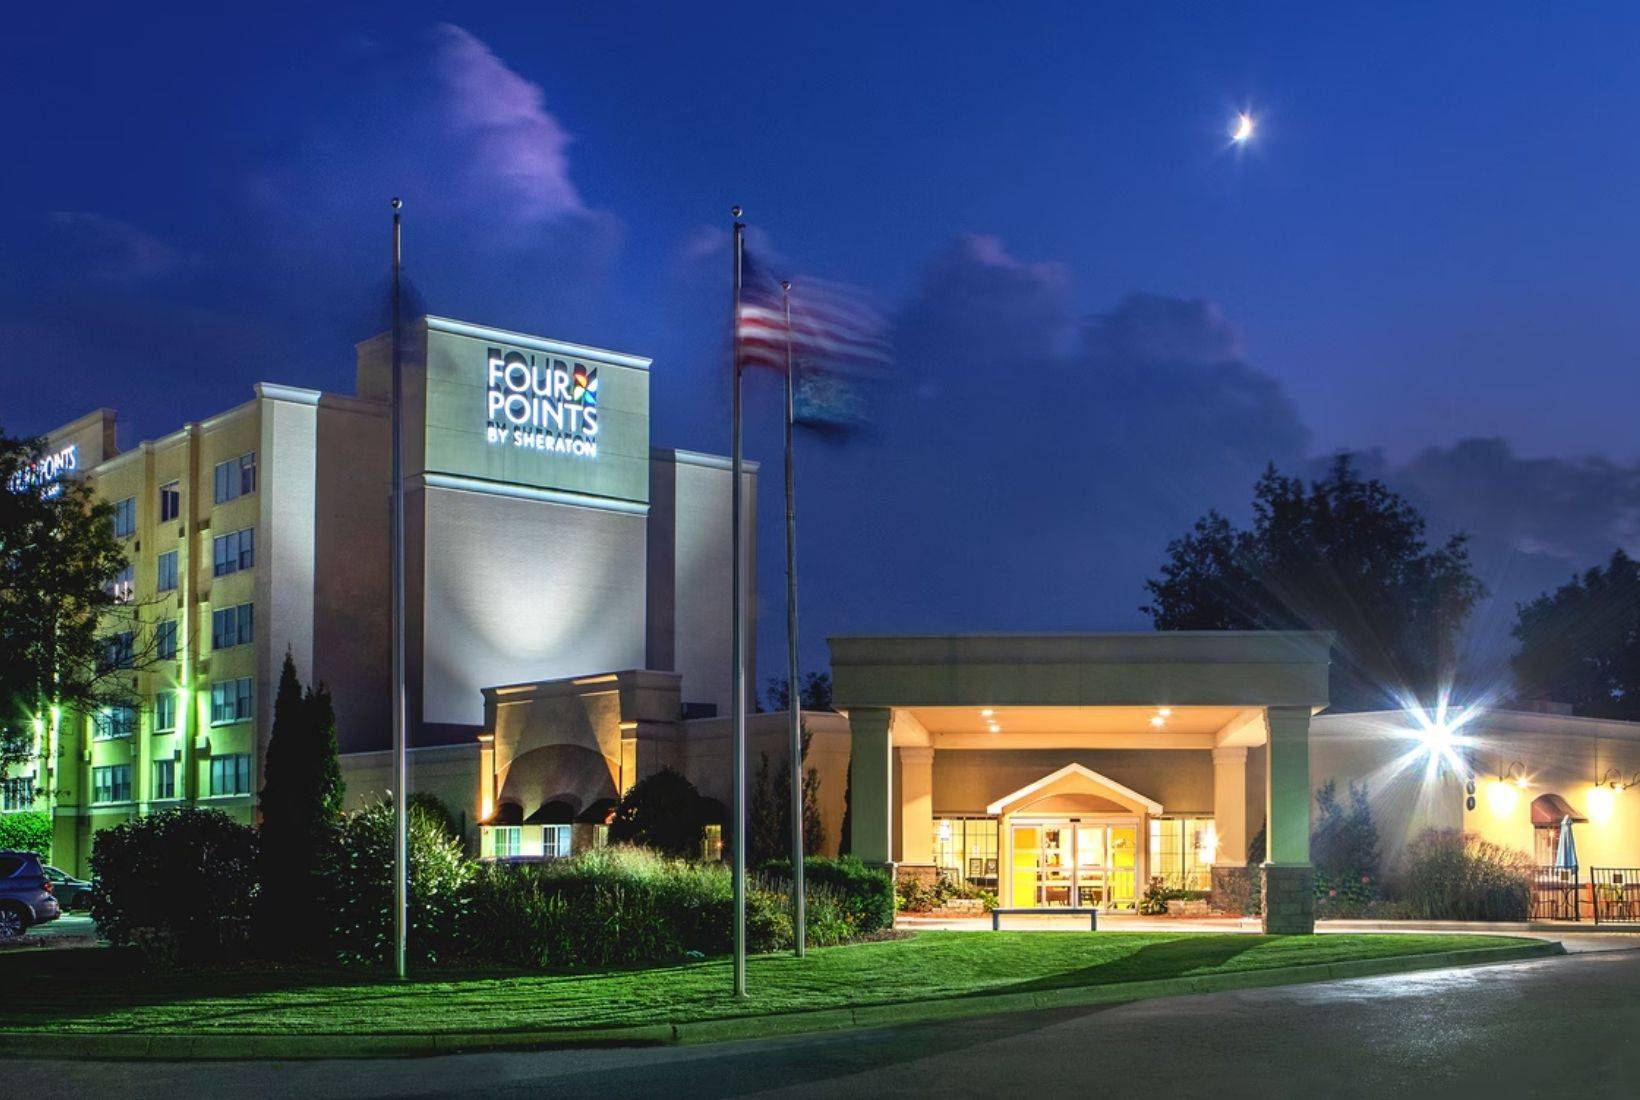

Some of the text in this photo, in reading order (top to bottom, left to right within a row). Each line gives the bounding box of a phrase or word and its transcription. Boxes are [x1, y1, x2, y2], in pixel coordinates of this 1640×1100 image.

[487, 357, 572, 401] FOUR
[487, 389, 598, 436] POINTS
[486, 427, 597, 458] BY SHERATON
